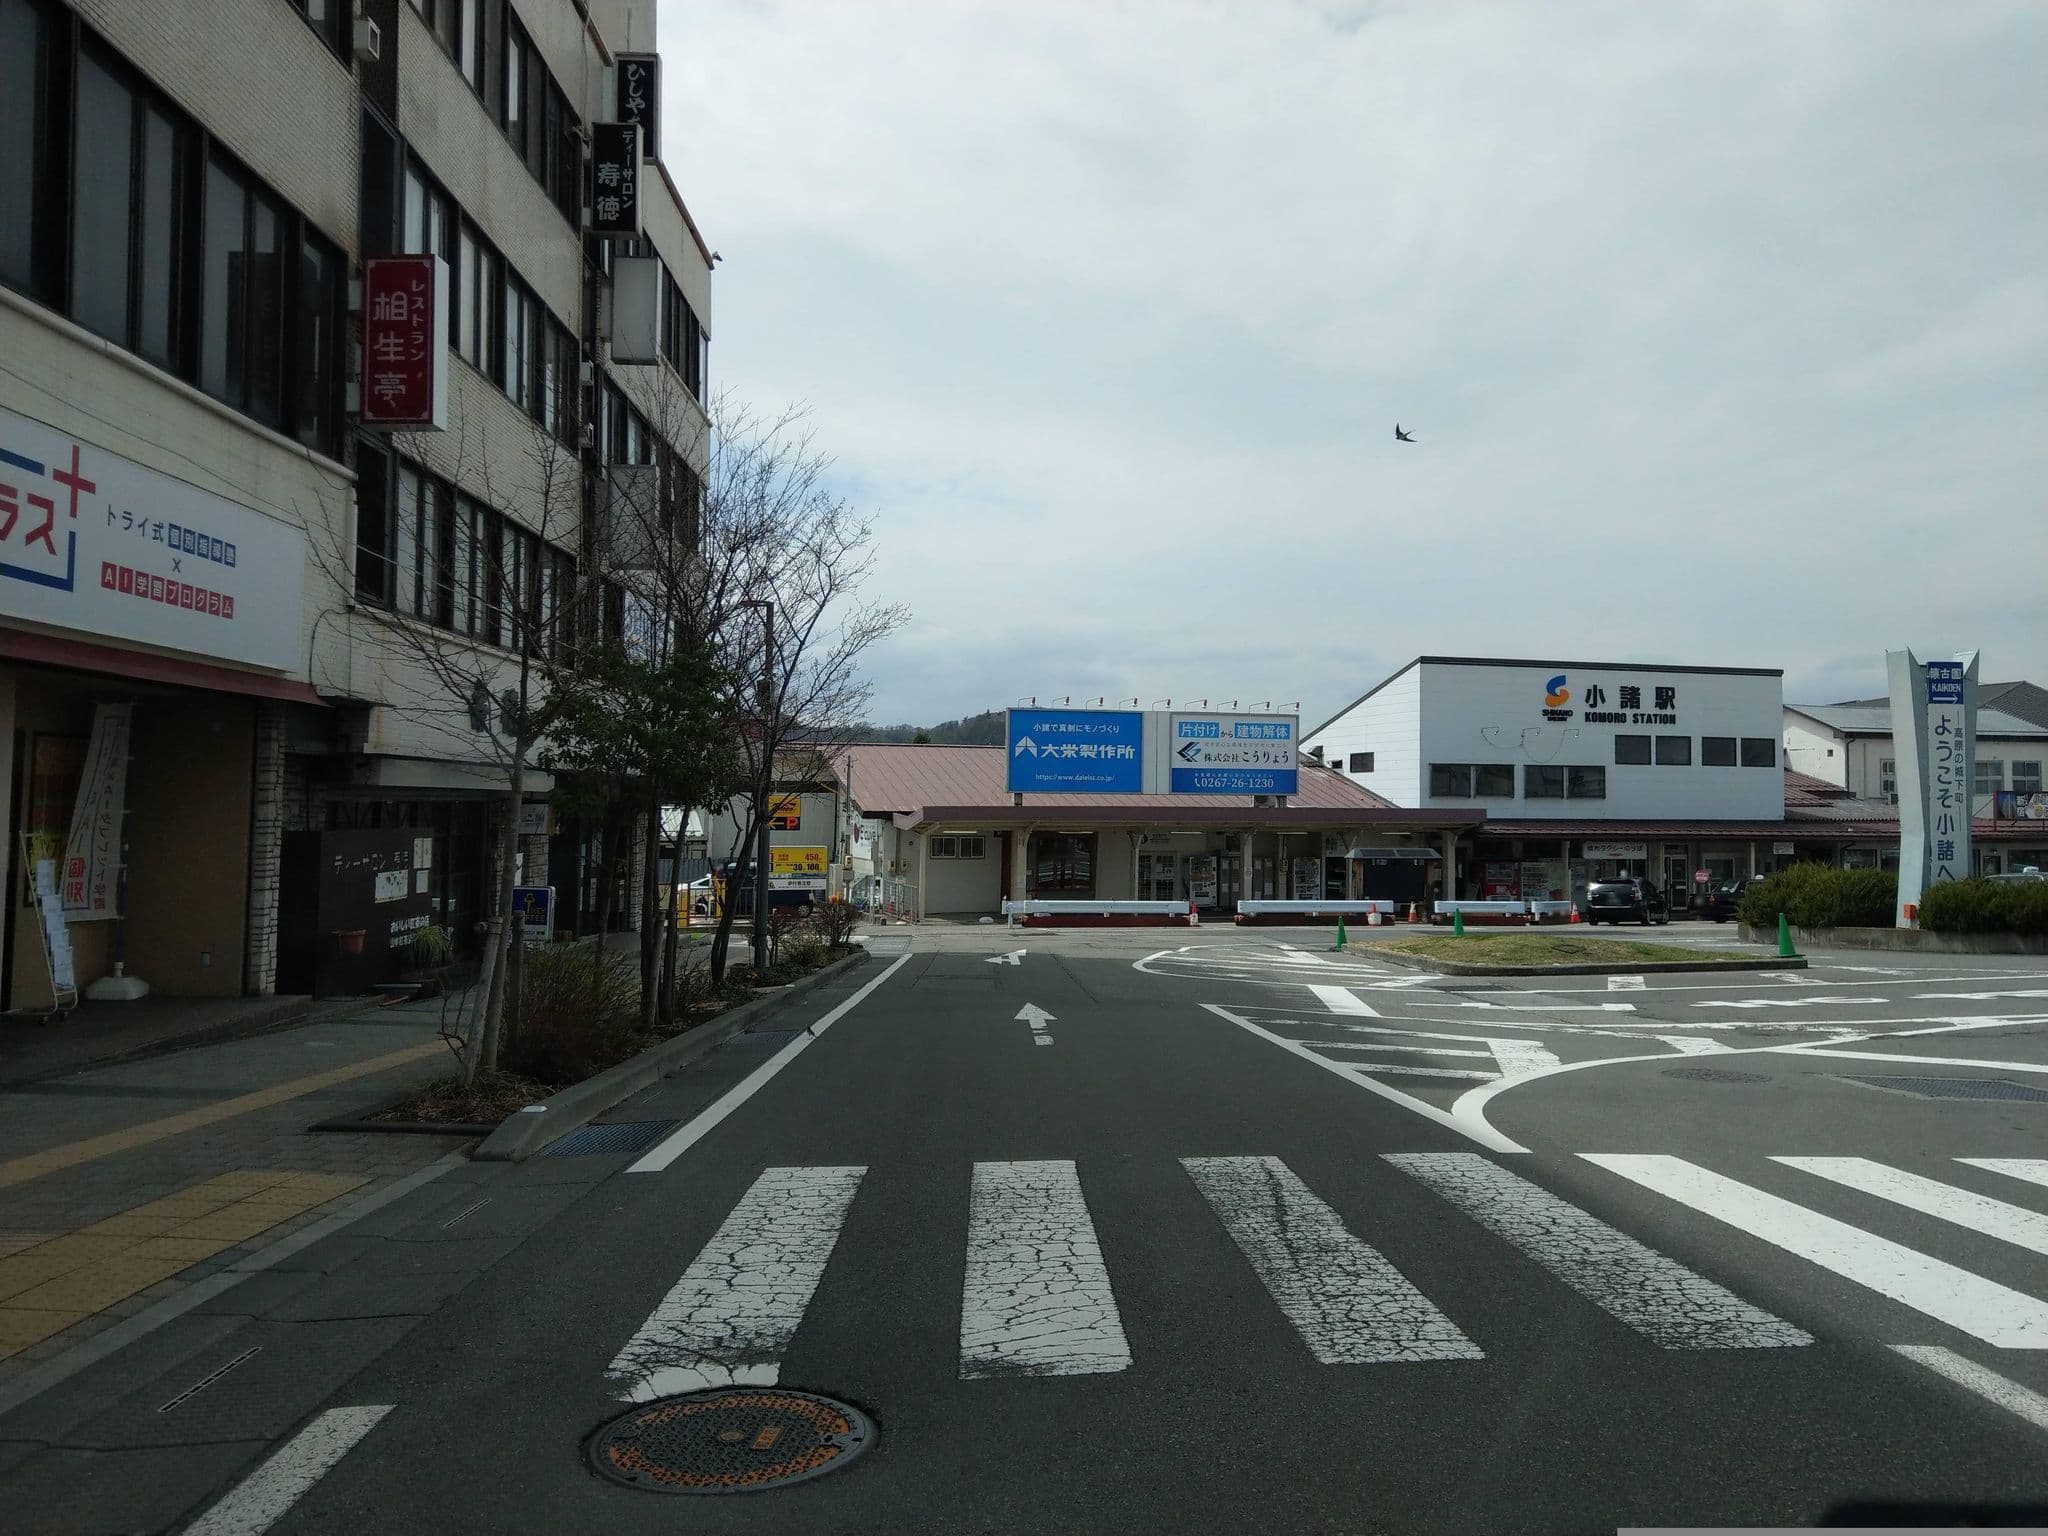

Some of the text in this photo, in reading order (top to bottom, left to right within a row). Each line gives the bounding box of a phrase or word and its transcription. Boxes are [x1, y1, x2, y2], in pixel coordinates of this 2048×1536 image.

[625, 63, 646, 122] ひしや
[622, 131, 635, 208] ティーサロン
[597, 162, 620, 221] 寿徳
[410, 279, 425, 361] レストラン
[372, 291, 409, 407] 相生亭
[1584, 684, 1676, 711] 小諸駅
[1931, 682, 1962, 693] KAIKOEN
[1584, 712, 1676, 725] KOMORO STATION
[1040, 743, 1136, 760] 大栄製作所
[1204, 750, 1289, 764] 株式会社こうりょう
[1201, 777, 1274, 789] 0267-26-1230
[1935, 714, 1956, 881] ようこそ小諸へ
[786, 817, 799, 830] P
